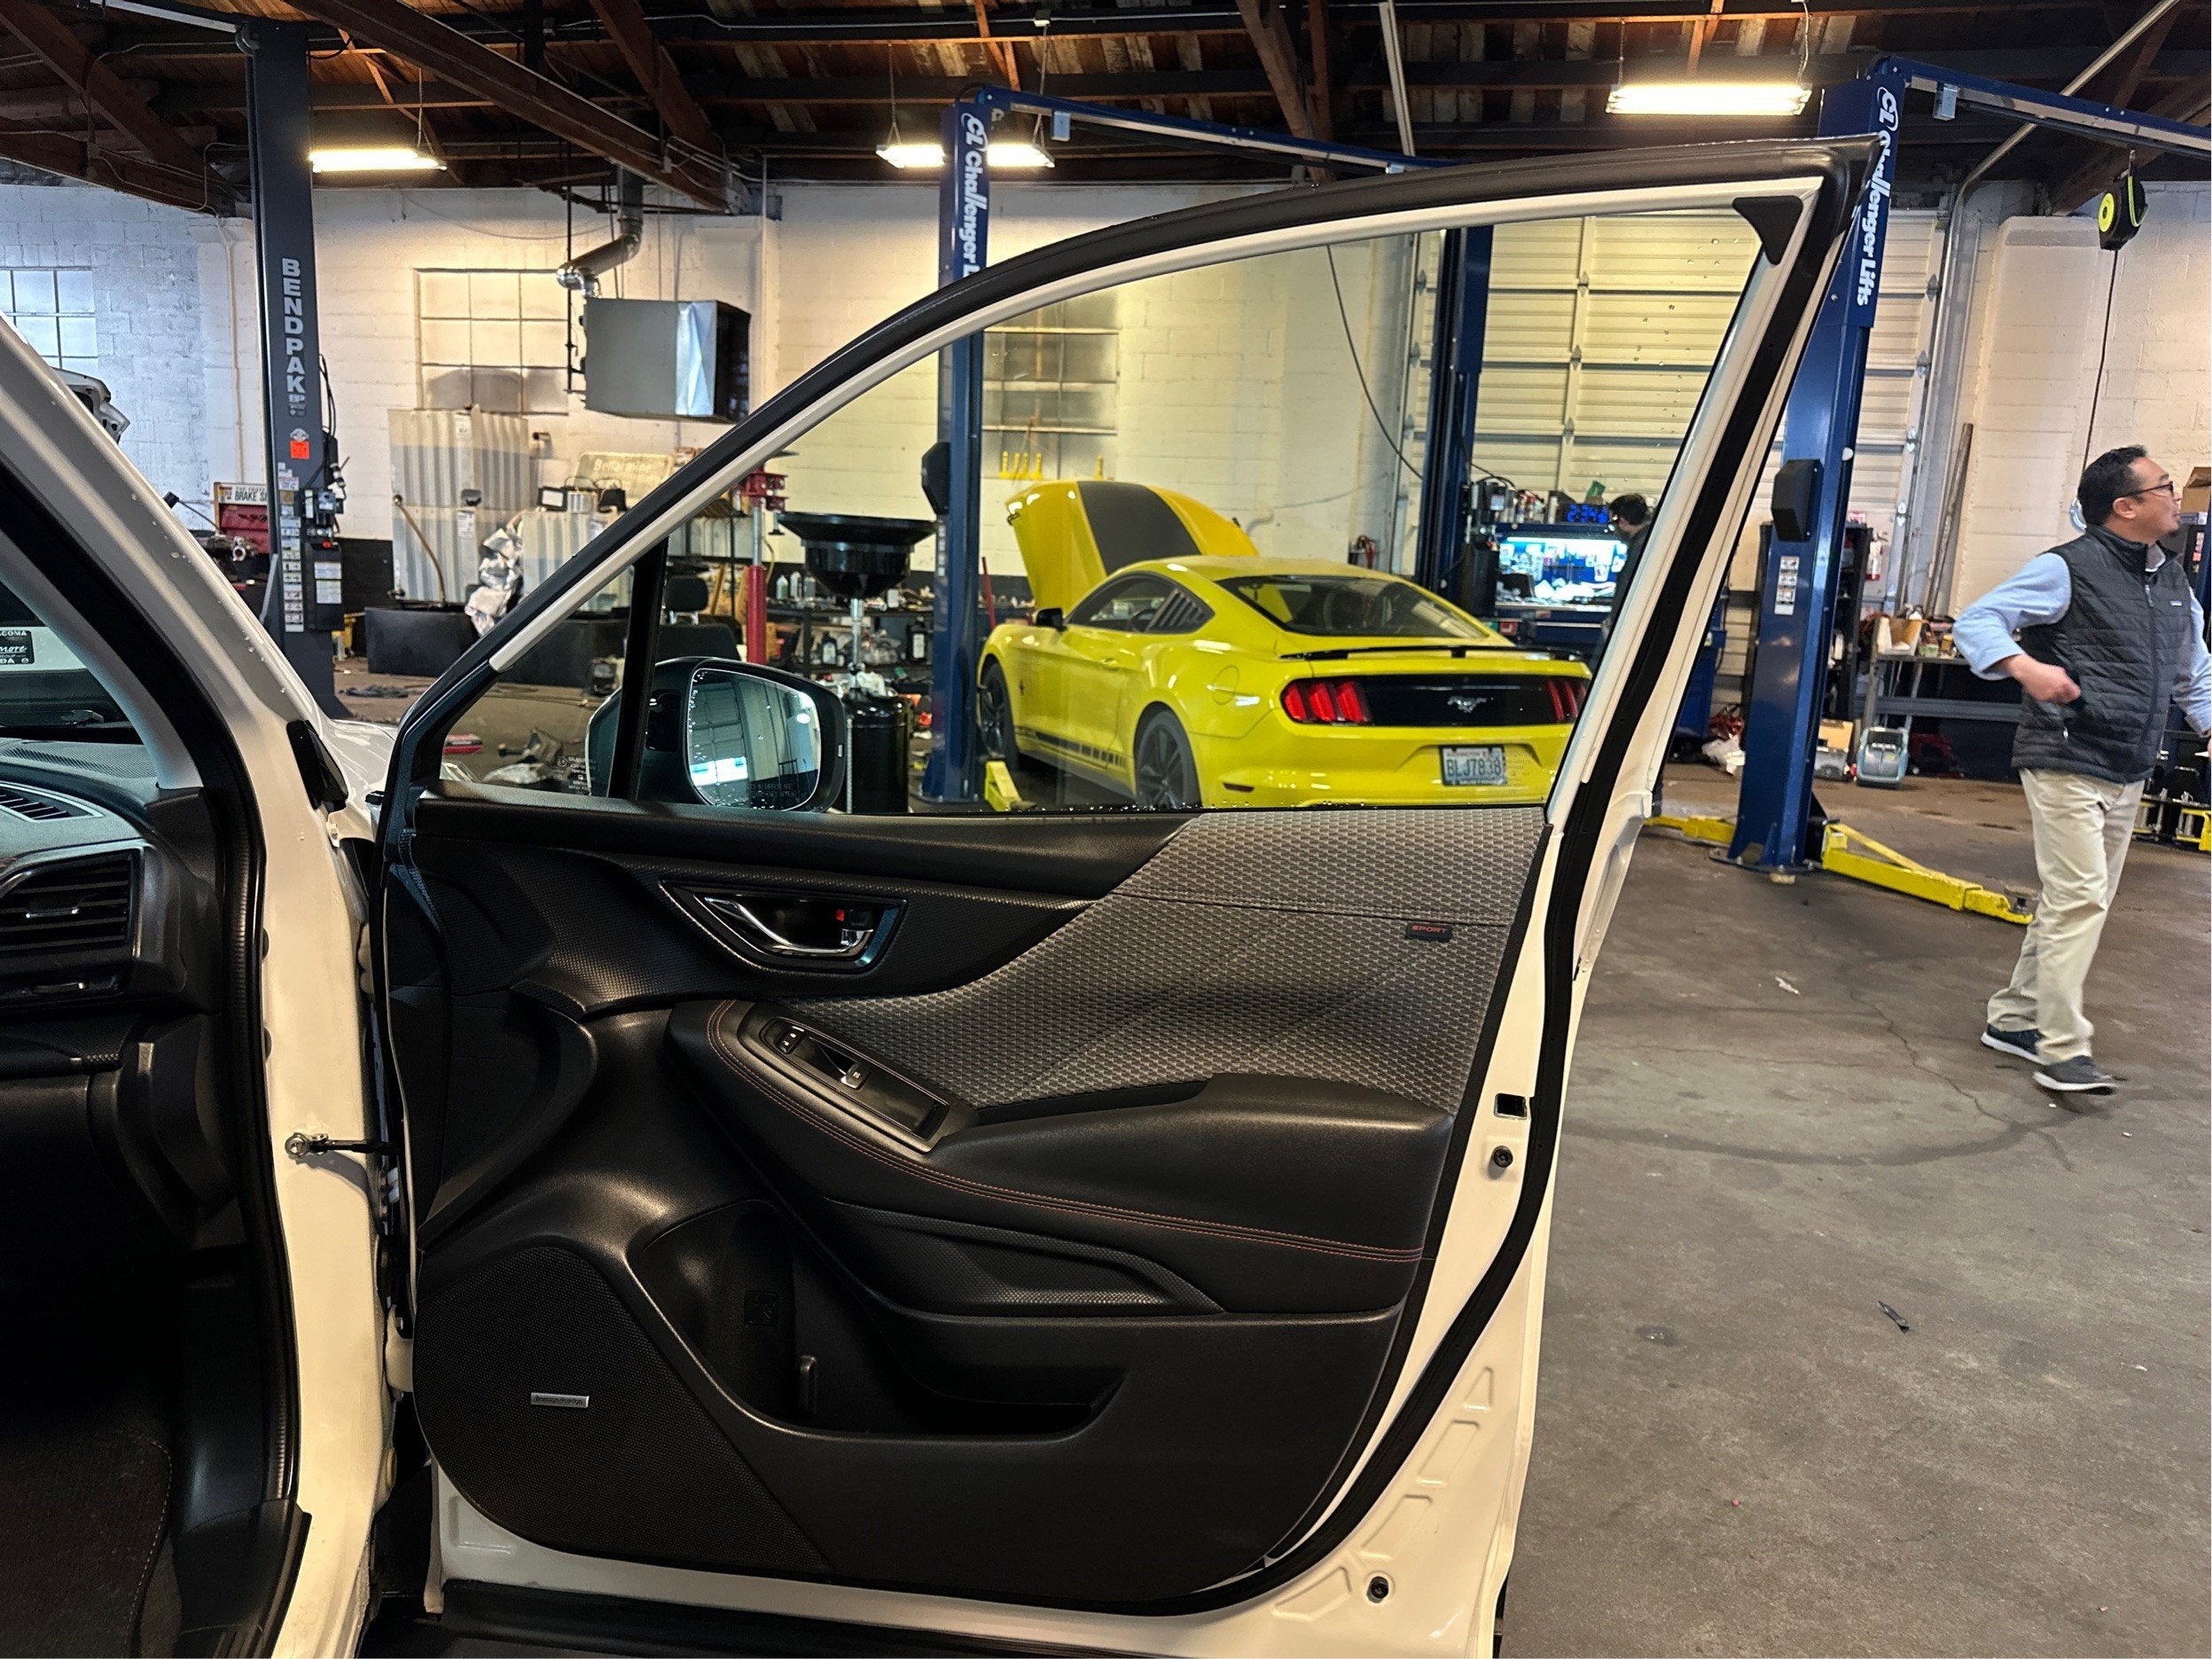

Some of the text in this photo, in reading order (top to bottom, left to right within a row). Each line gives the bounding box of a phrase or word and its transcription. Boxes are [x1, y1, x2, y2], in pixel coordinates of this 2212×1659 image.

[958, 151, 989, 263] Challenger
[1857, 258, 1876, 306] Lifts
[282, 258, 307, 393] BENDPAK
[235, 491, 257, 502] BRAKE
